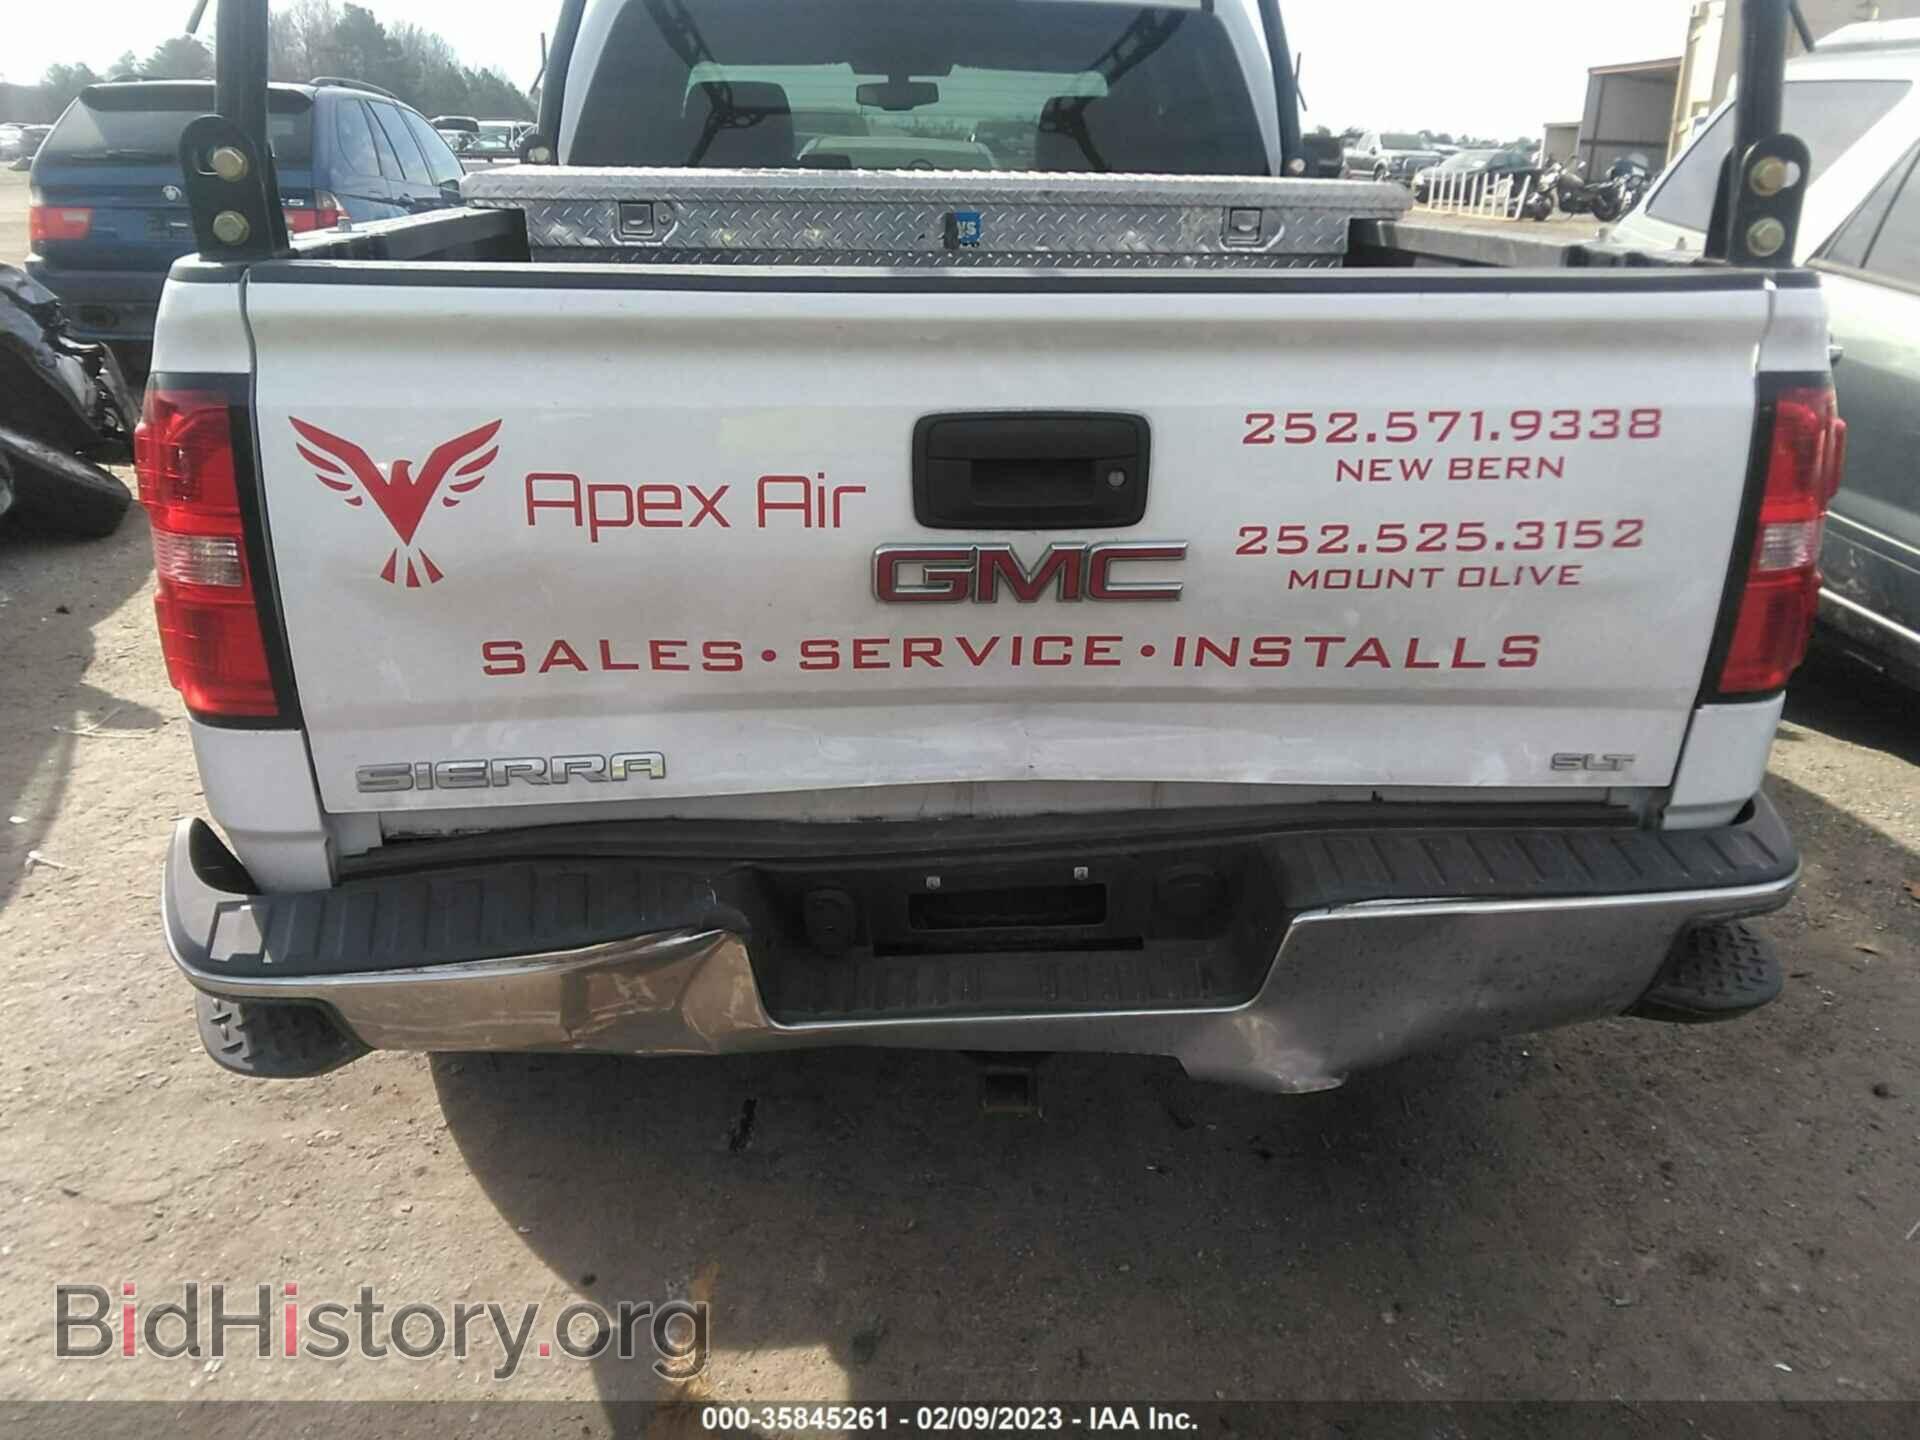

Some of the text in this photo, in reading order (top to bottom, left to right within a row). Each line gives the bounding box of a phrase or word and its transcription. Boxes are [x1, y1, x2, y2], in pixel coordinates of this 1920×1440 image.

[1242, 407, 1662, 445] 252.571.9338
[1335, 455, 1566, 482] NEW BERN
[525, 472, 866, 543] Apex Air
[1235, 518, 1645, 556] 252.525.3152
[871, 541, 1189, 603] GMC
[1287, 564, 1583, 590] MOUNT OLIVE
[483, 633, 1540, 675] SALES SERVICE INSTALLS
[356, 751, 666, 793] SIERRA
[1551, 752, 1635, 771] SLT
